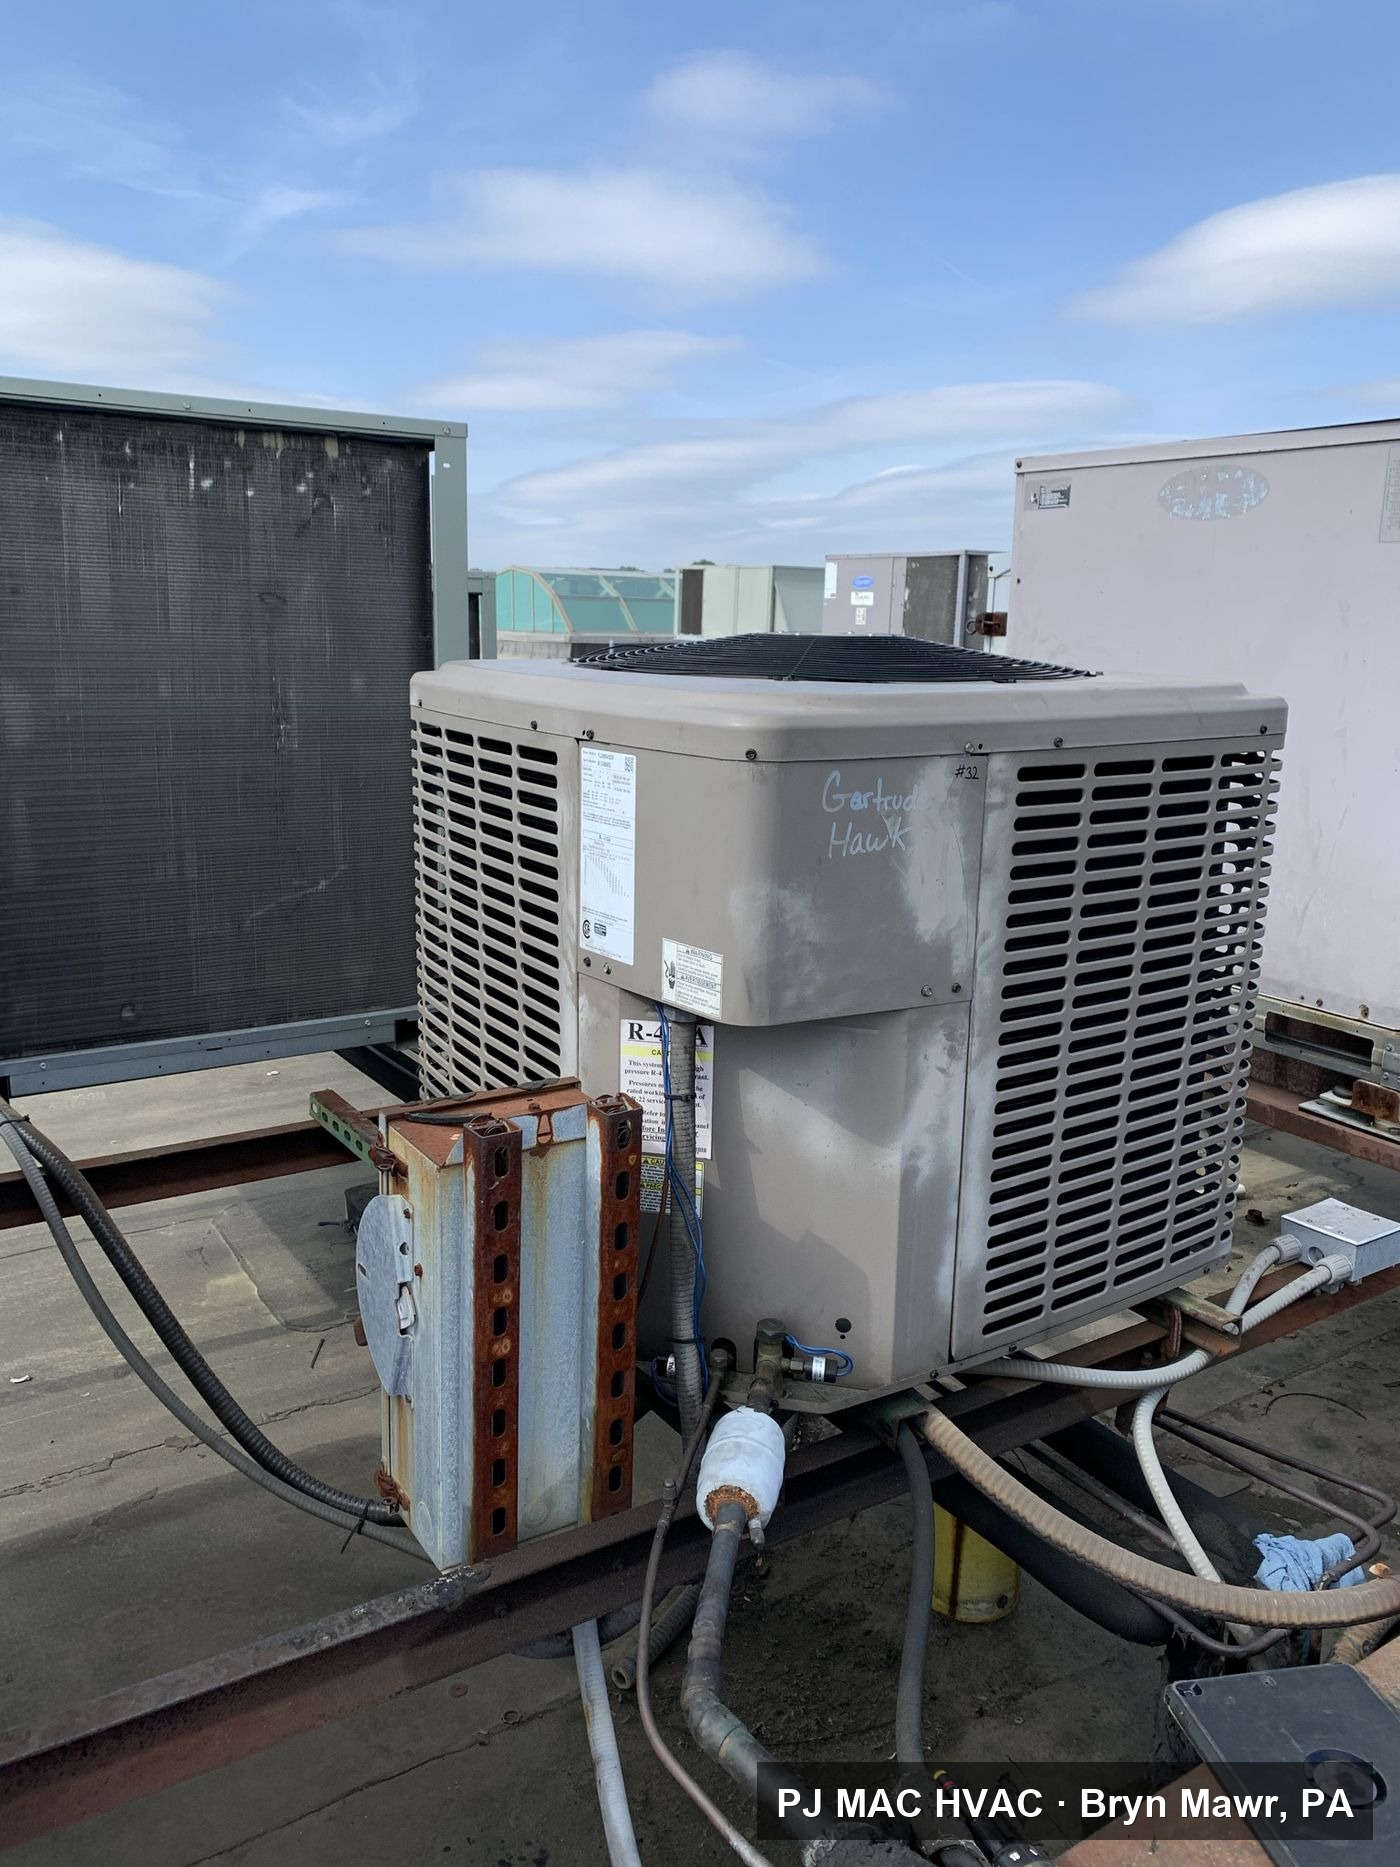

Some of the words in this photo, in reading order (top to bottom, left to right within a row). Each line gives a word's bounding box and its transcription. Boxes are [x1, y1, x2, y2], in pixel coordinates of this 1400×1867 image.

[954, 764, 980, 780] #32
[627, 1021, 709, 1048] R-4A
[628, 1080, 657, 1088] Pressures
